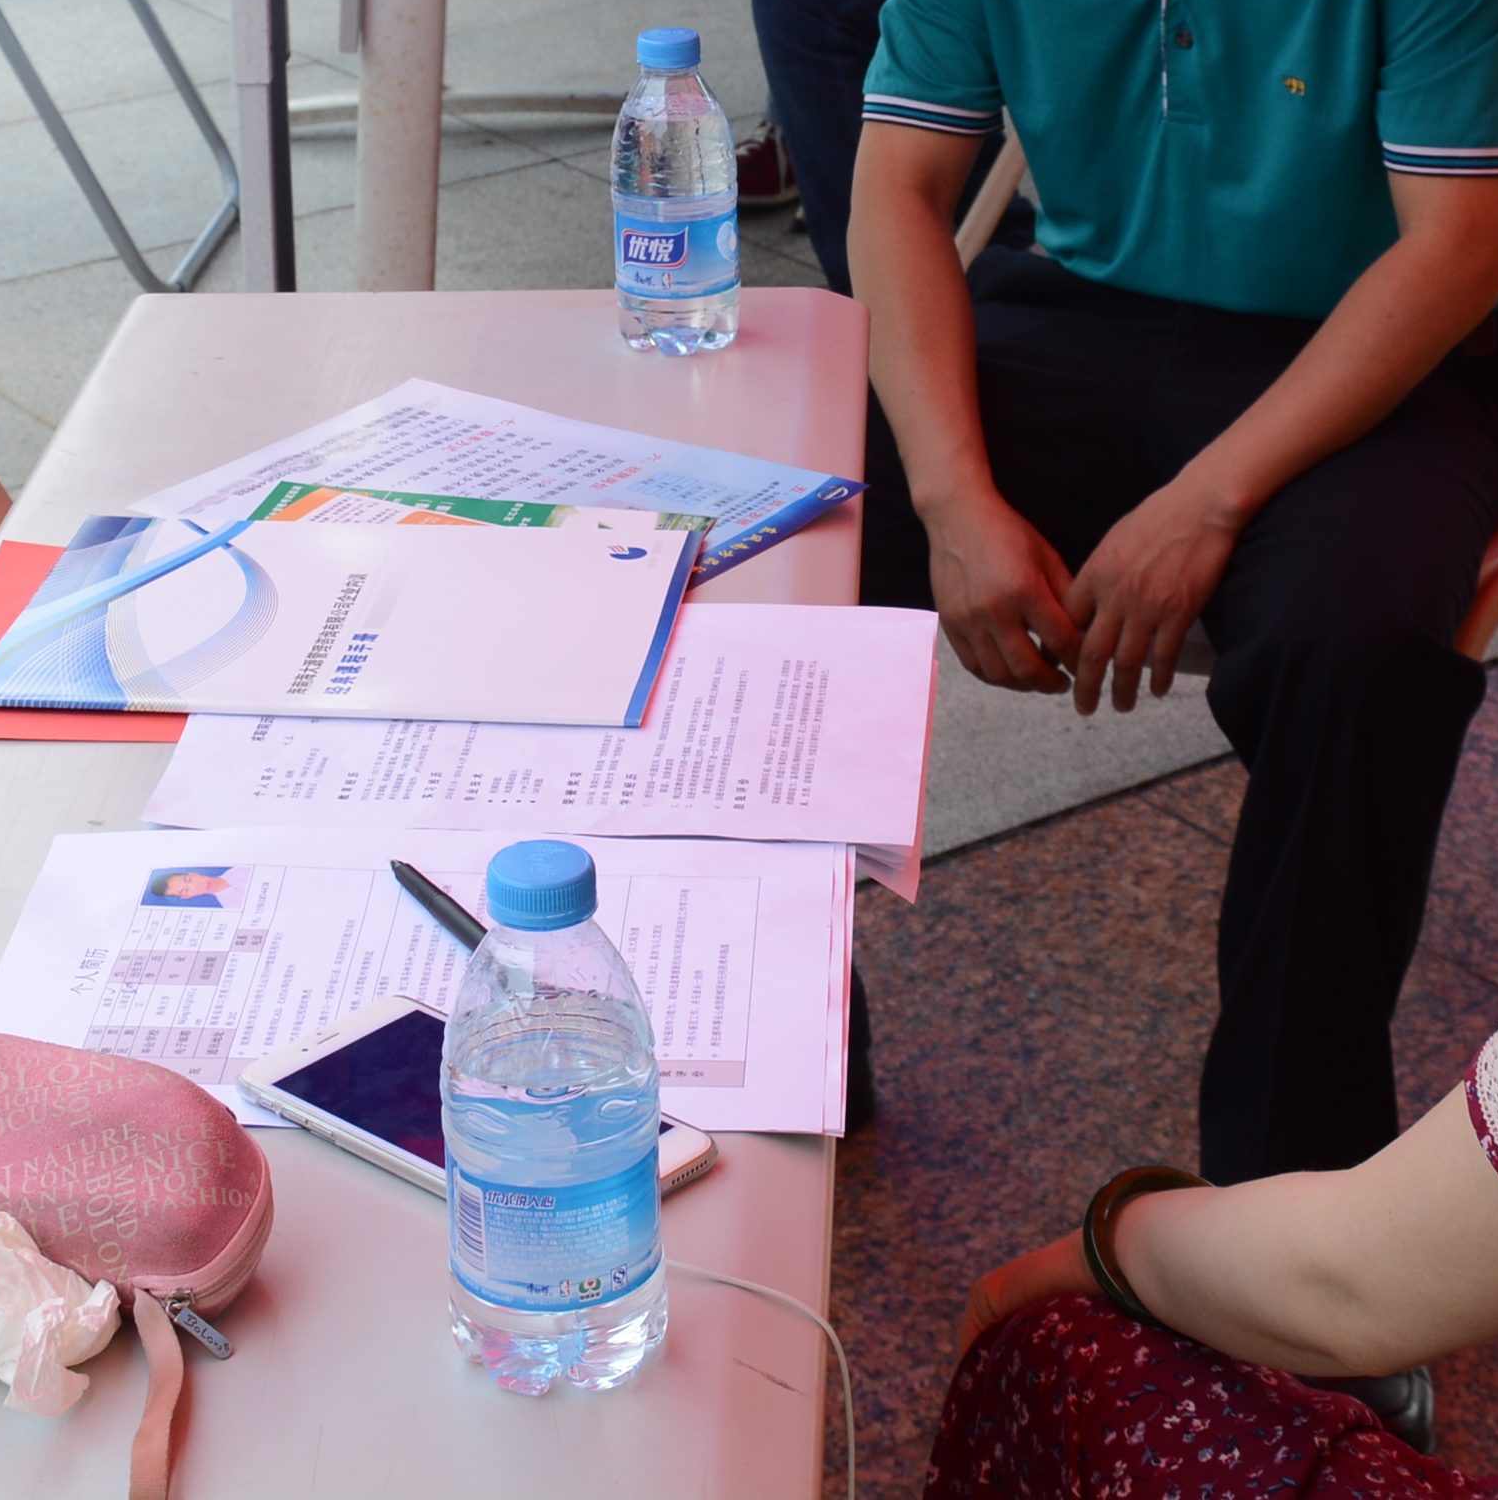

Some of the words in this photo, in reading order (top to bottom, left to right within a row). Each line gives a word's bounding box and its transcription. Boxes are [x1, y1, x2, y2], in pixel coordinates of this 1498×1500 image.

[627, 235, 676, 263] 优悦
[67, 947, 110, 995] 个人简历
[68, 1080, 92, 1127] HOT
[21, 1121, 218, 1195] CONFIDENCE
[23, 1119, 142, 1178] NATURE
[141, 1140, 237, 1180] NICE
[114, 1162, 139, 1240] MIND
[141, 1166, 210, 1199] TOP
[142, 1186, 259, 1218] FASHION
[484, 1189, 557, 1211] 优水悦人心
[85, 1171, 136, 1286] BOLON
